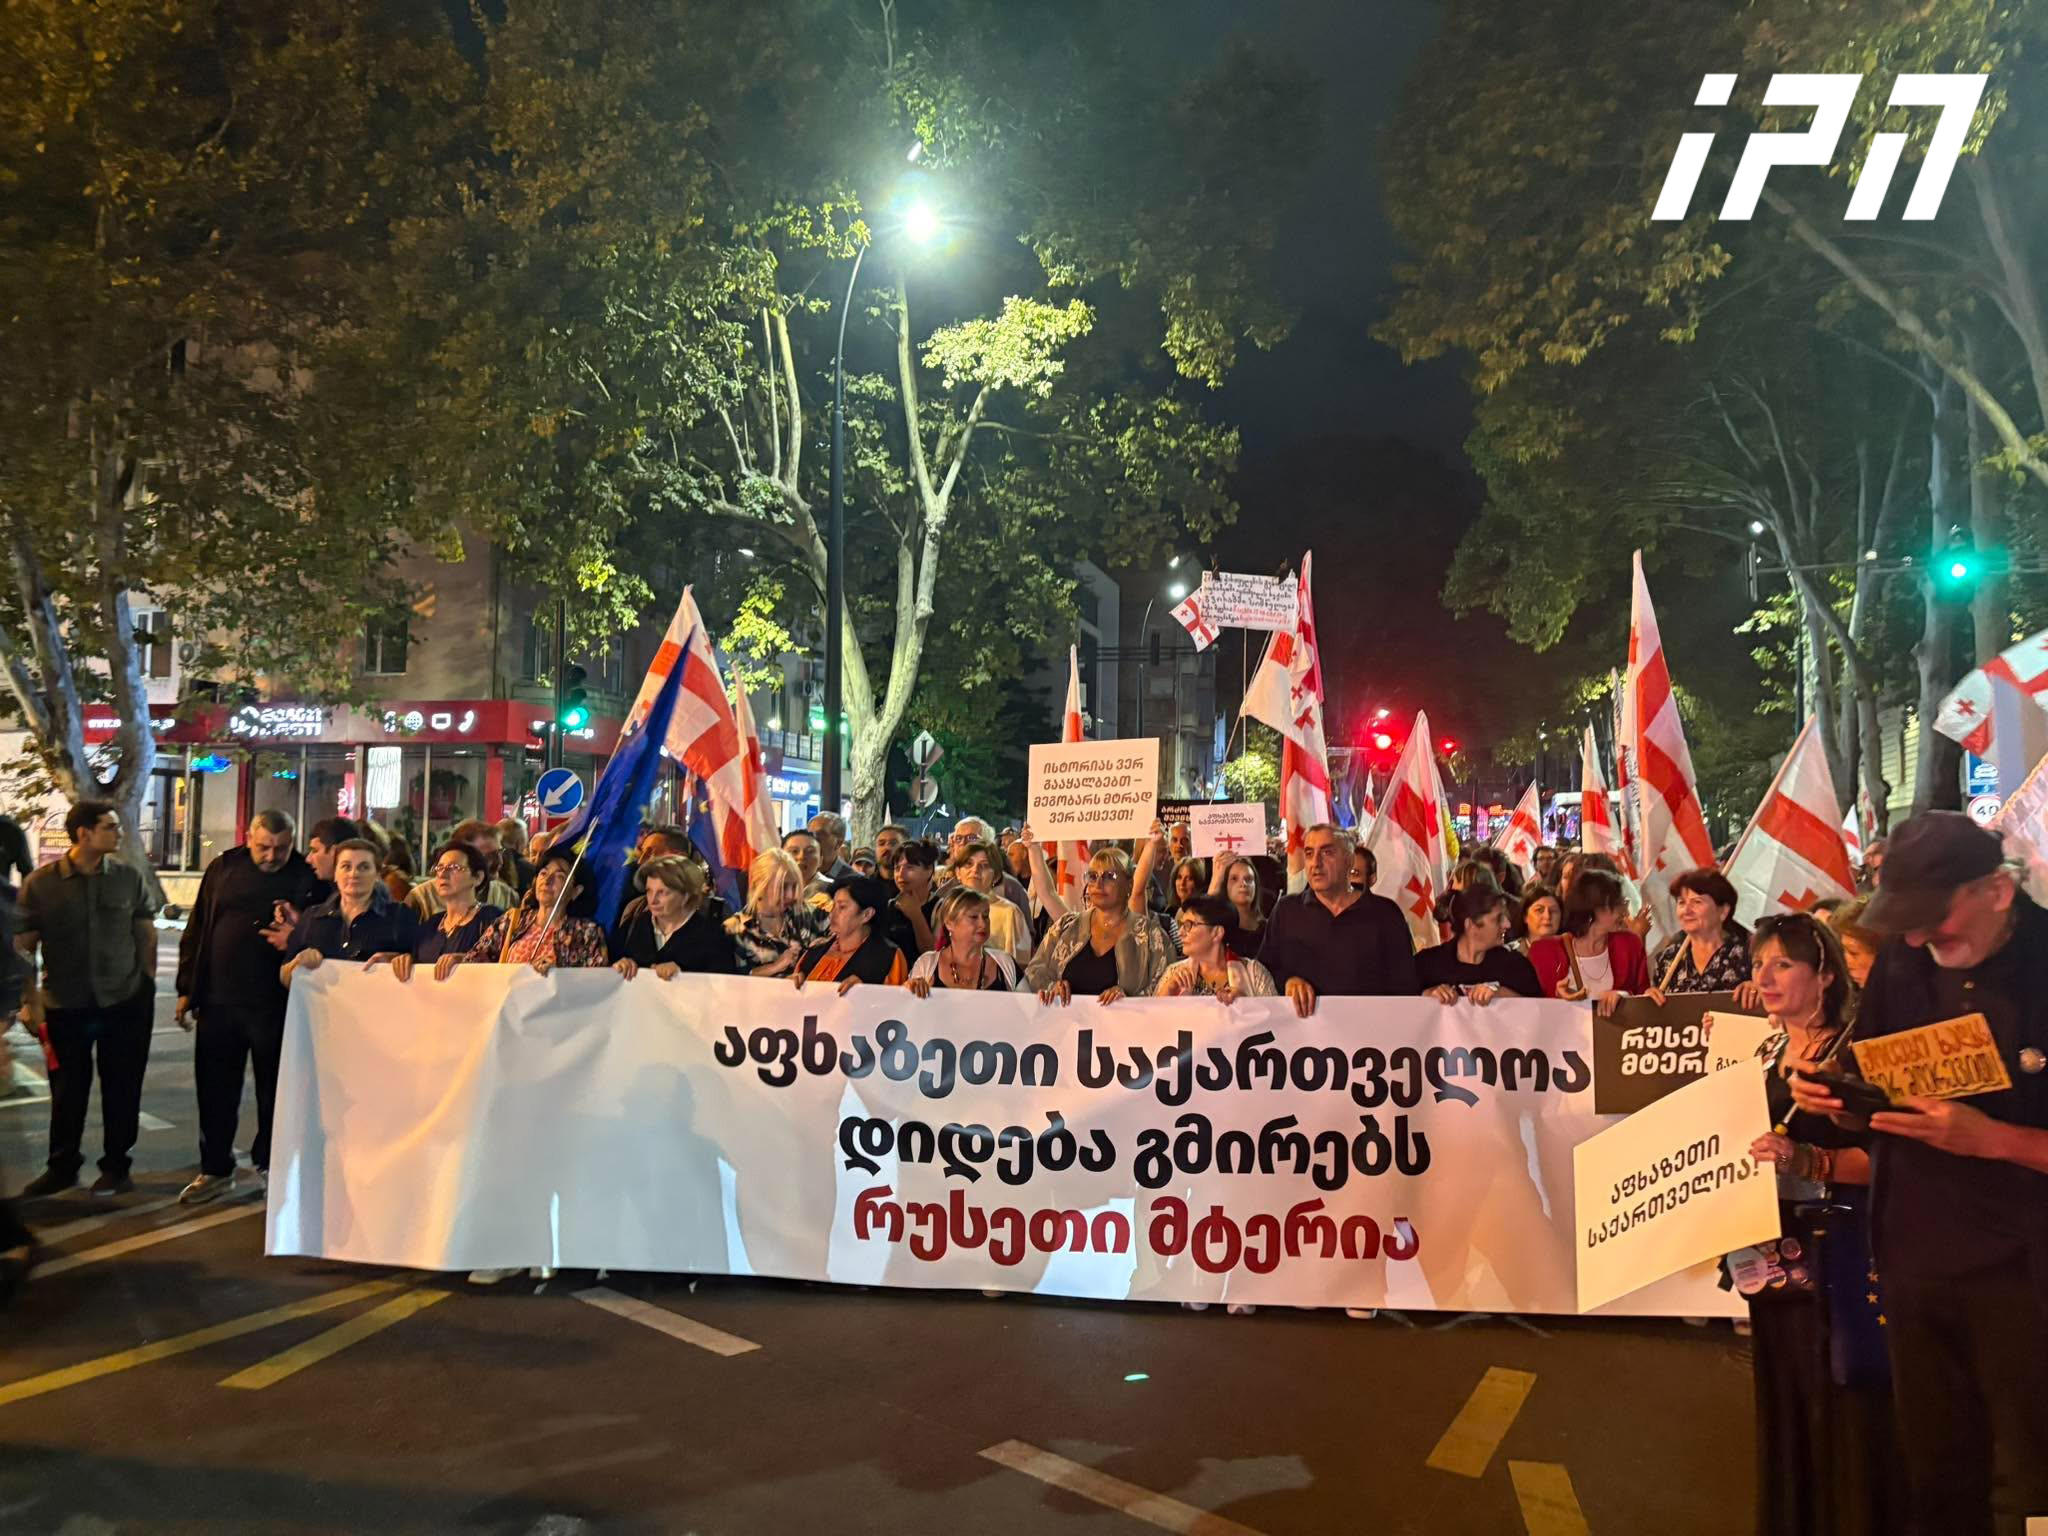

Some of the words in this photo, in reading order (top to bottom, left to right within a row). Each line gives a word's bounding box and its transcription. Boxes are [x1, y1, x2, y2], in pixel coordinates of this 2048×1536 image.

[1043, 759, 1113, 773] ისტორიას
[1116, 757, 1143, 771] ვერ
[1043, 775, 1131, 790] გააყალბებთ
[1033, 792, 1100, 807] მეგობარს
[1103, 791, 1152, 804] მტრად
[1049, 811, 1074, 823] ვერ
[1077, 809, 1134, 822] აქცევთ!
[1976, 805, 1999, 817] 40
[714, 1015, 1058, 1099] აფხაზეთი
[1077, 1029, 1591, 1108] საქართველოა
[839, 1110, 1116, 1185] დიდება
[1133, 1112, 1431, 1191] გმირებს
[1611, 1134, 1720, 1204] აფხაზეთი
[1588, 1157, 1759, 1248] საქართველოა!
[854, 1185, 1129, 1266] რუსეთი
[1149, 1196, 1419, 1274] მტერია
